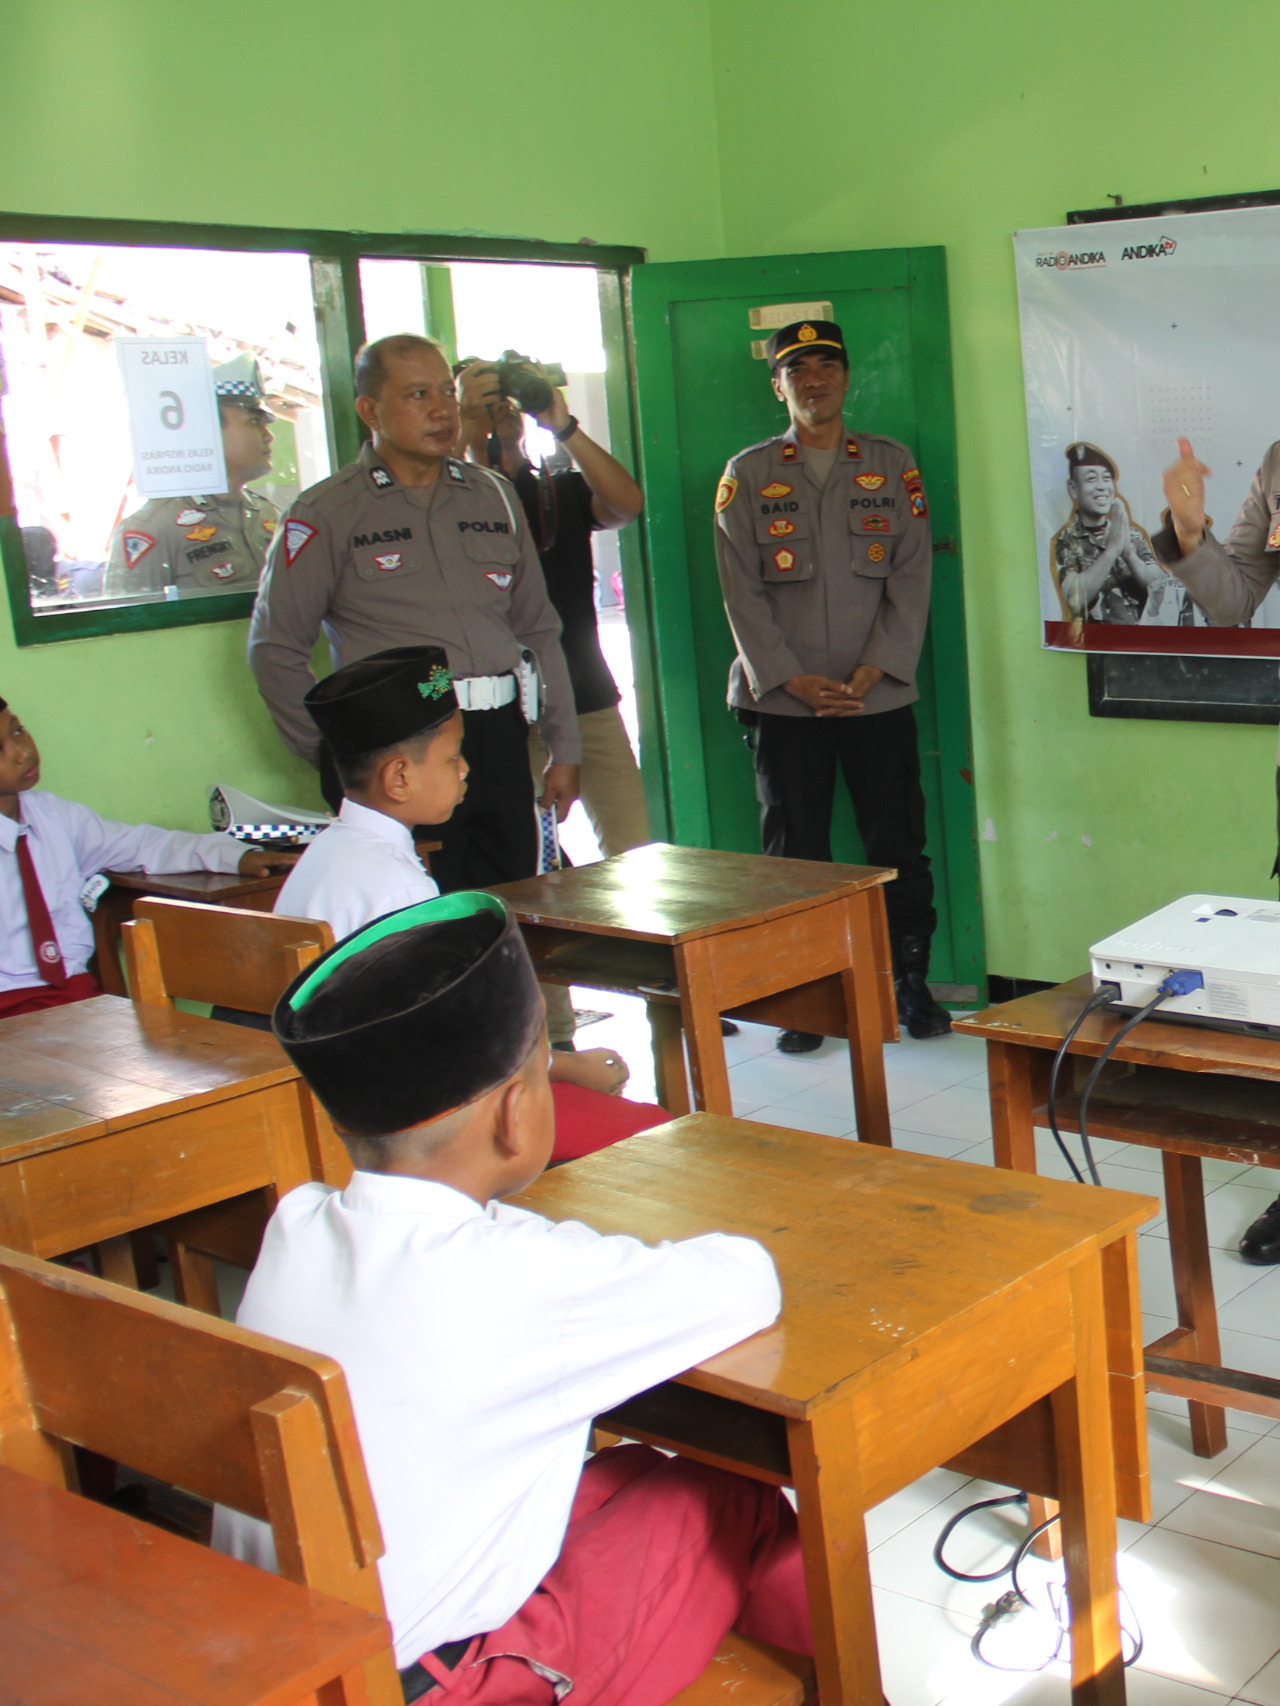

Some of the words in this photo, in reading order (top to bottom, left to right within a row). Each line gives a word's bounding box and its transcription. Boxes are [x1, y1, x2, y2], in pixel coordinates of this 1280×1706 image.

[1068, 251, 1106, 266] ANDIKA
[1121, 243, 1167, 261] ANDIKA
[761, 501, 799, 515] SAID
[850, 497, 895, 510] POLRI
[457, 521, 509, 535] POLRI
[353, 527, 413, 548] MASNI
